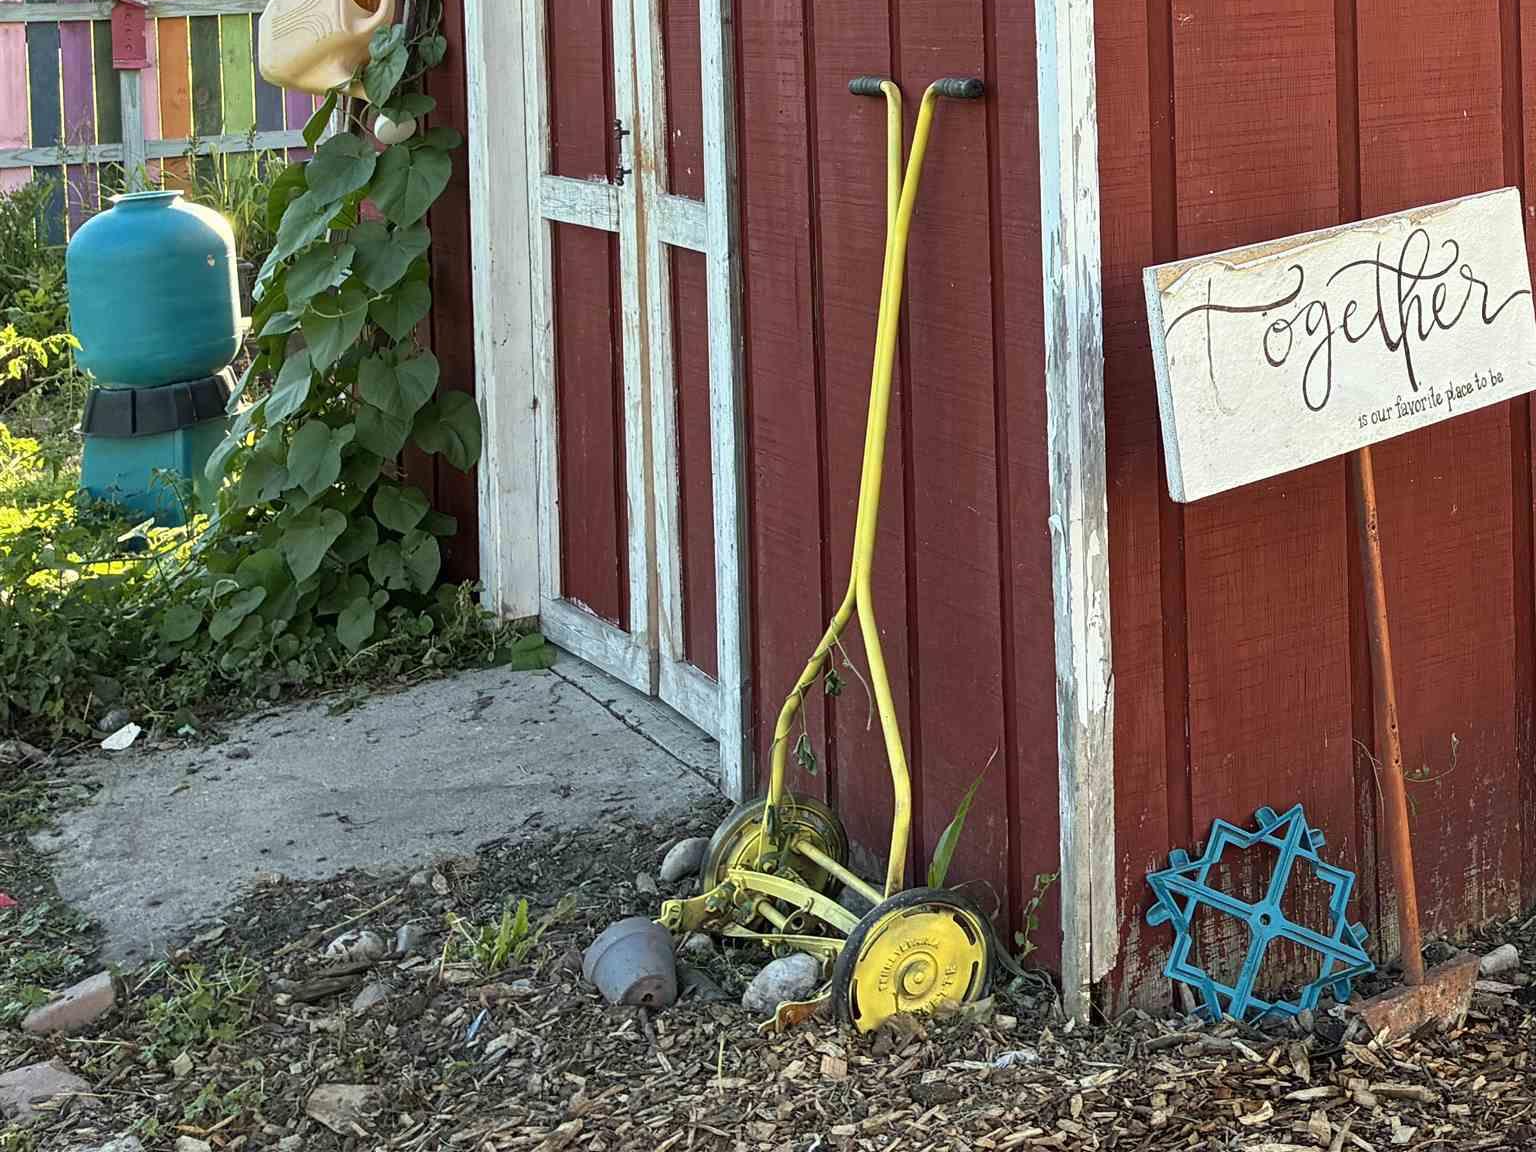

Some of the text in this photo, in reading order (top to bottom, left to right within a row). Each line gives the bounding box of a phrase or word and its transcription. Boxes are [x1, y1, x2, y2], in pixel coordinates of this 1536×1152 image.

[1165, 228, 1530, 414] Together
[1358, 368, 1504, 428] is our favorite place to be
